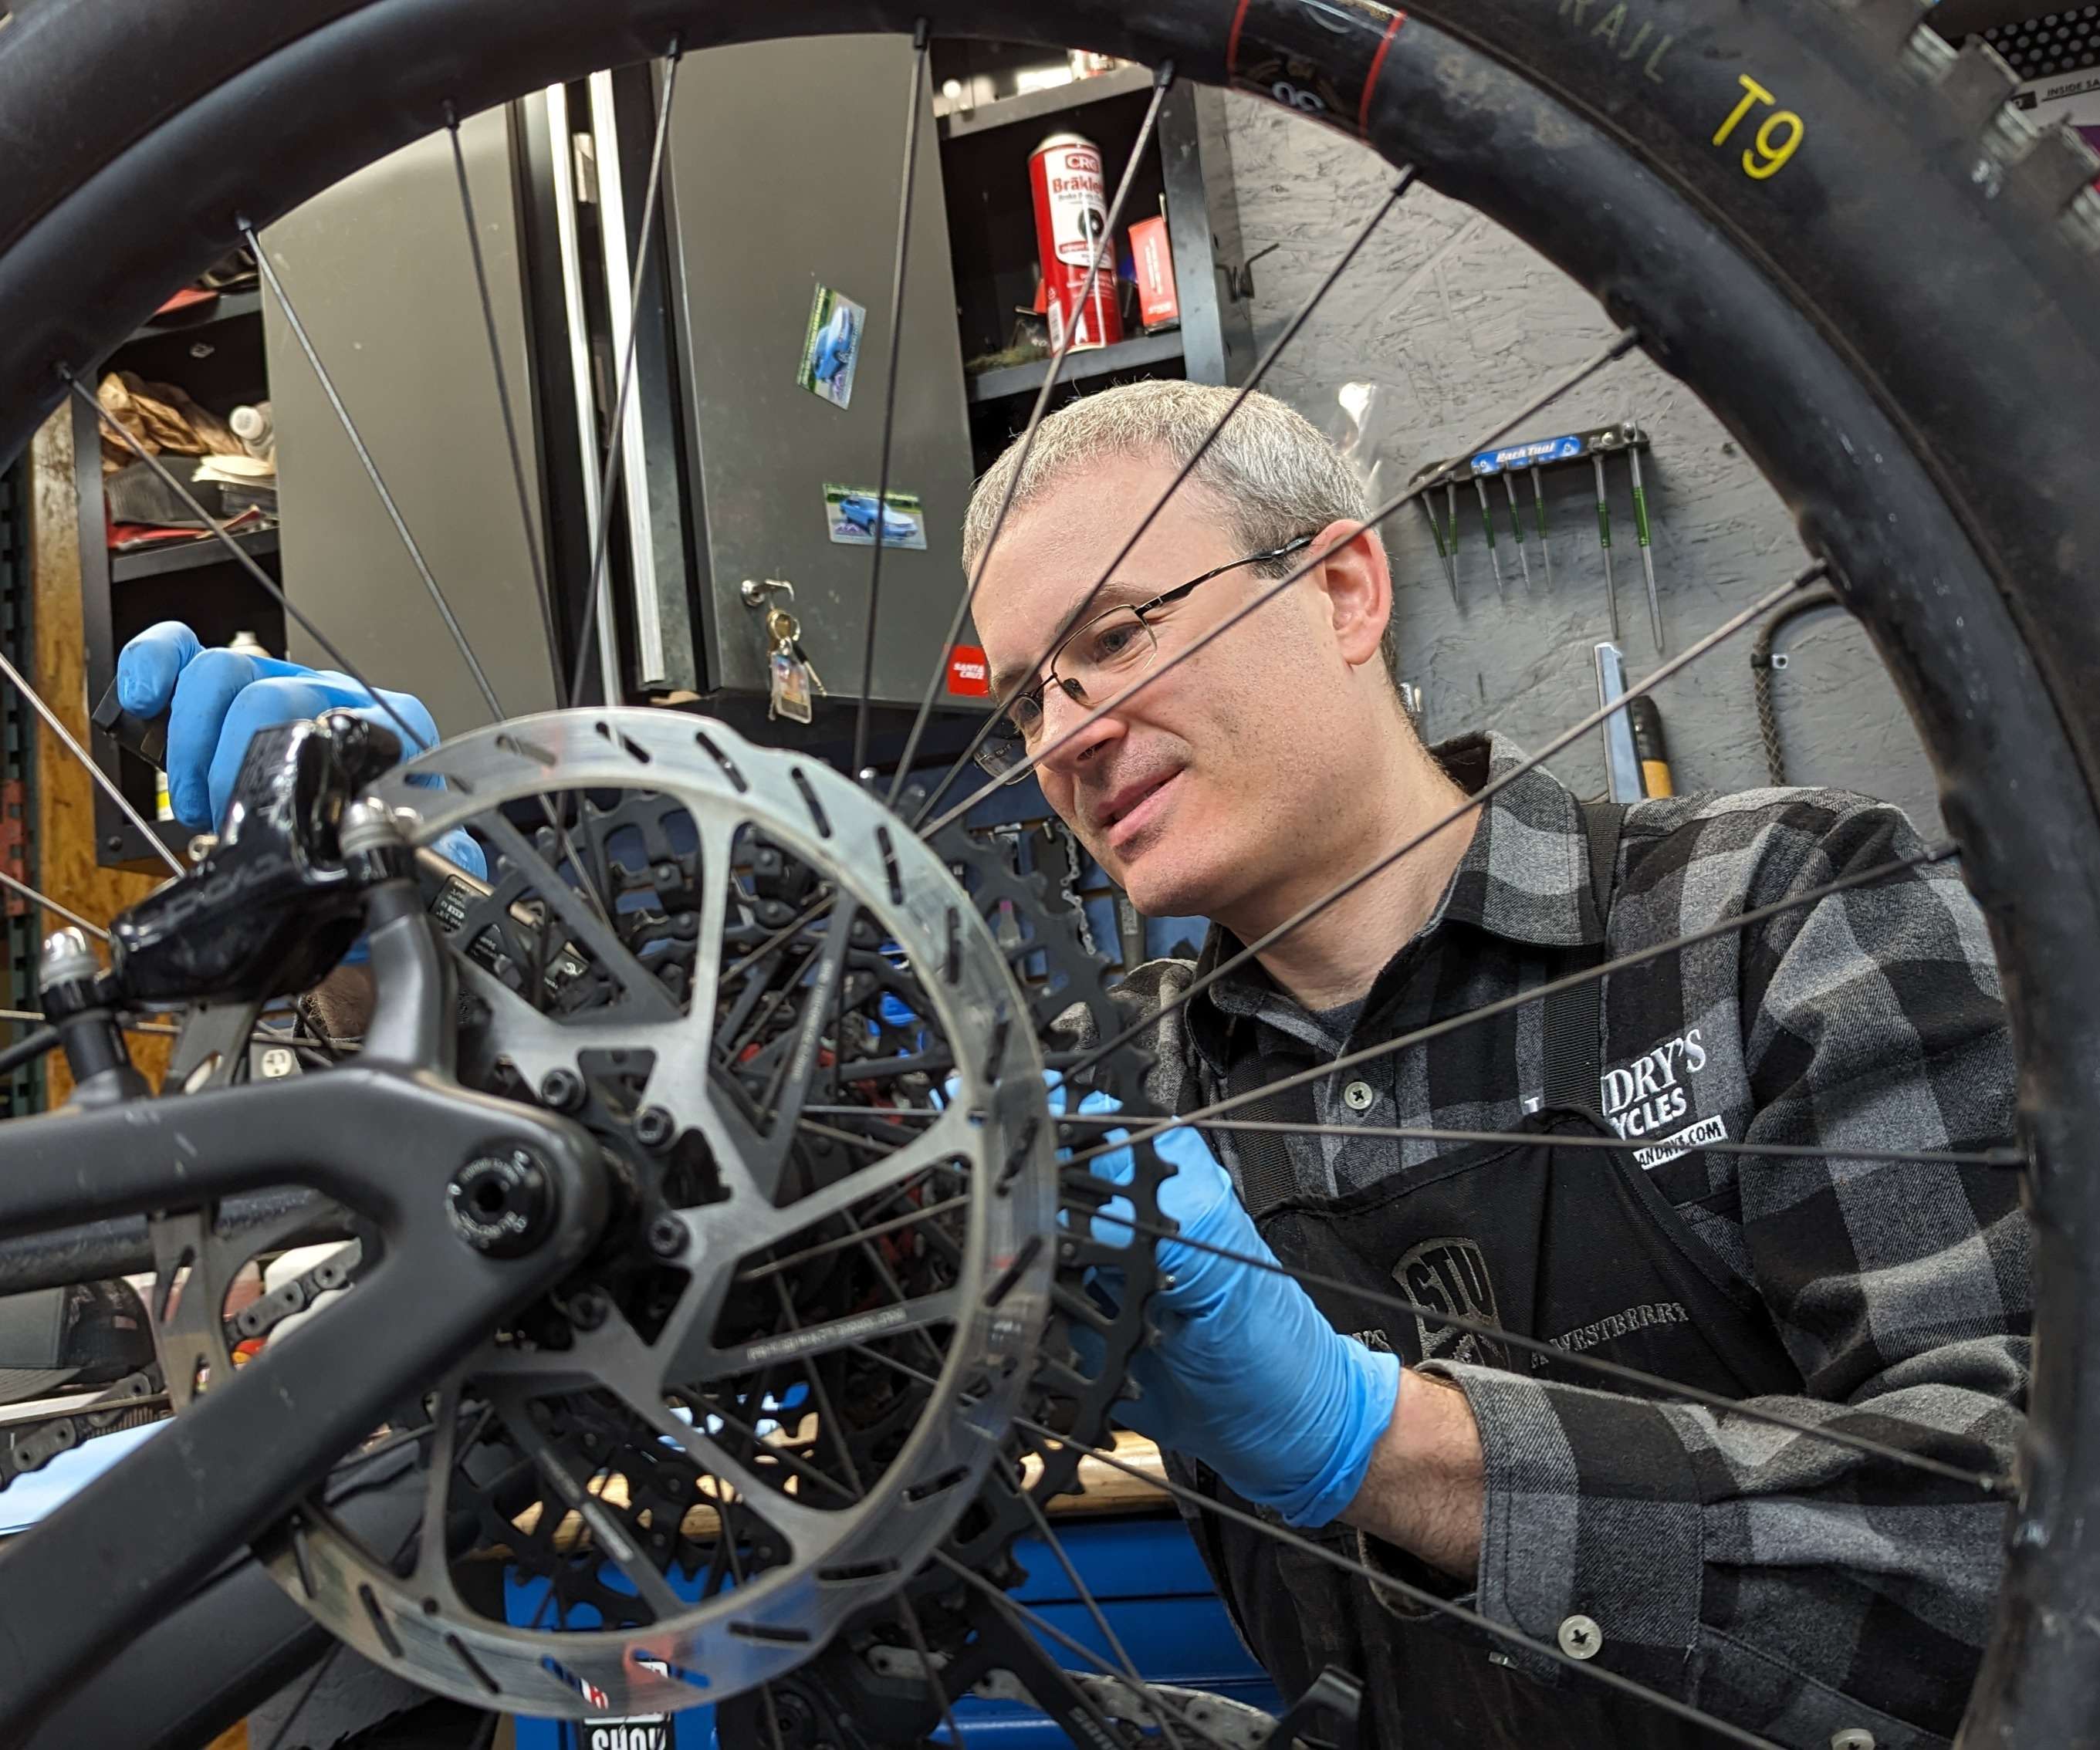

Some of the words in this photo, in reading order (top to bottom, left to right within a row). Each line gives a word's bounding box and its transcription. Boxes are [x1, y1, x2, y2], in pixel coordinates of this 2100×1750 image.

[2047, 82, 2082, 97] INSIDE
[1712, 73, 1804, 180] T9
[1496, 447, 1527, 463] Park
[1527, 442, 1556, 456] Tool
[953, 662, 983, 672] SANTA
[959, 671, 983, 679] CRUZ
